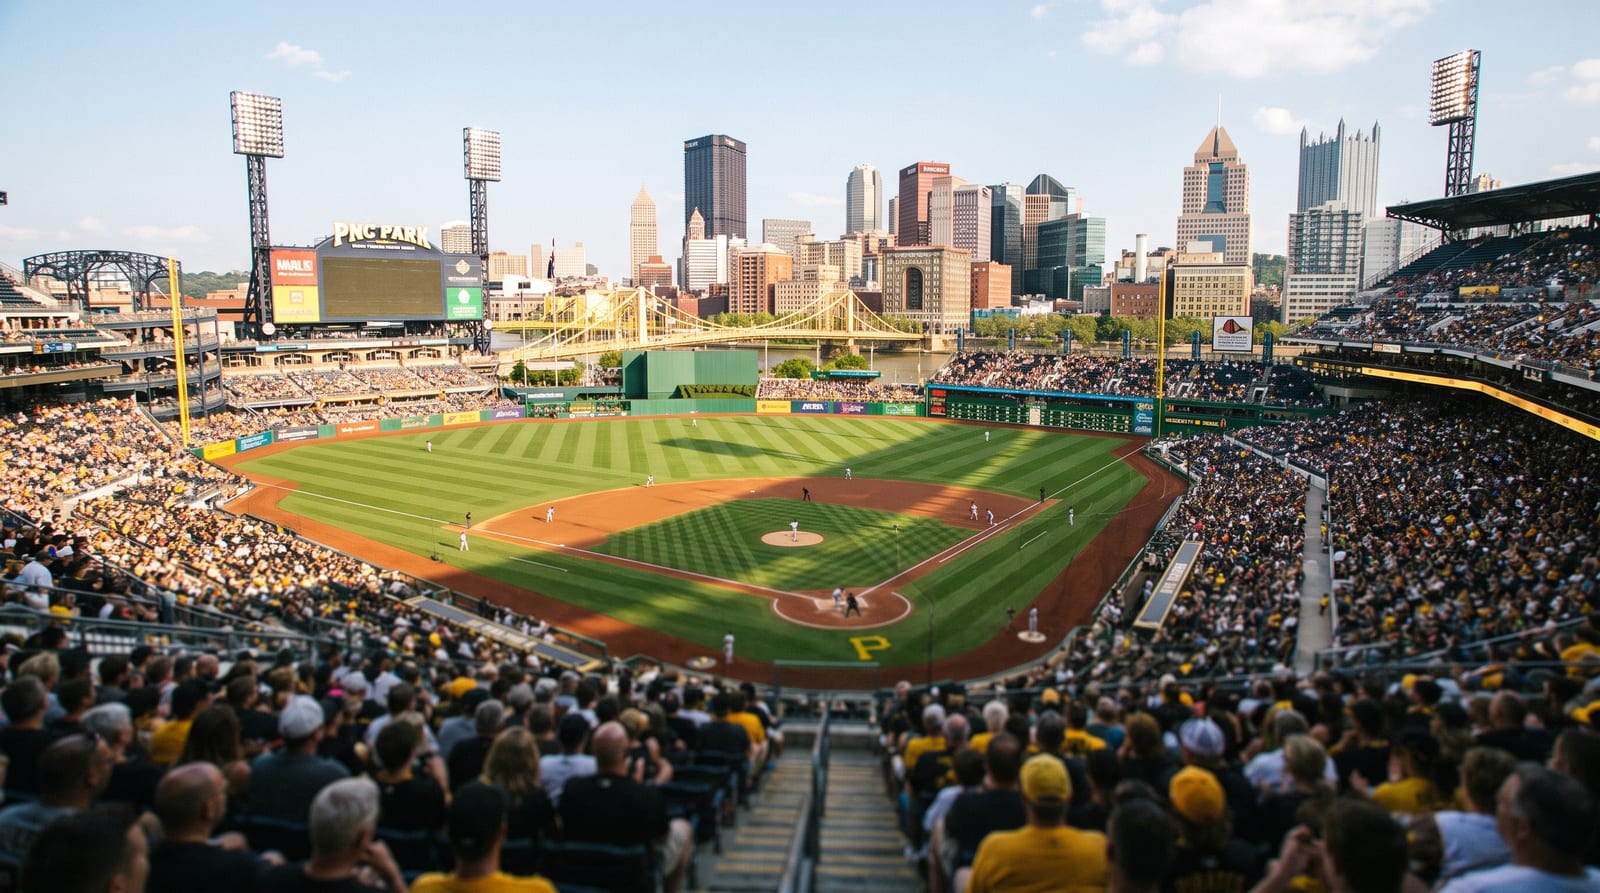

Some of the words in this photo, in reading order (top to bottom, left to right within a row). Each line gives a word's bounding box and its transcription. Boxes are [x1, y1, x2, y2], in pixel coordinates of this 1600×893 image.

[333, 222, 376, 248] PNC
[380, 224, 431, 250] PARK
[848, 635, 892, 661] P
